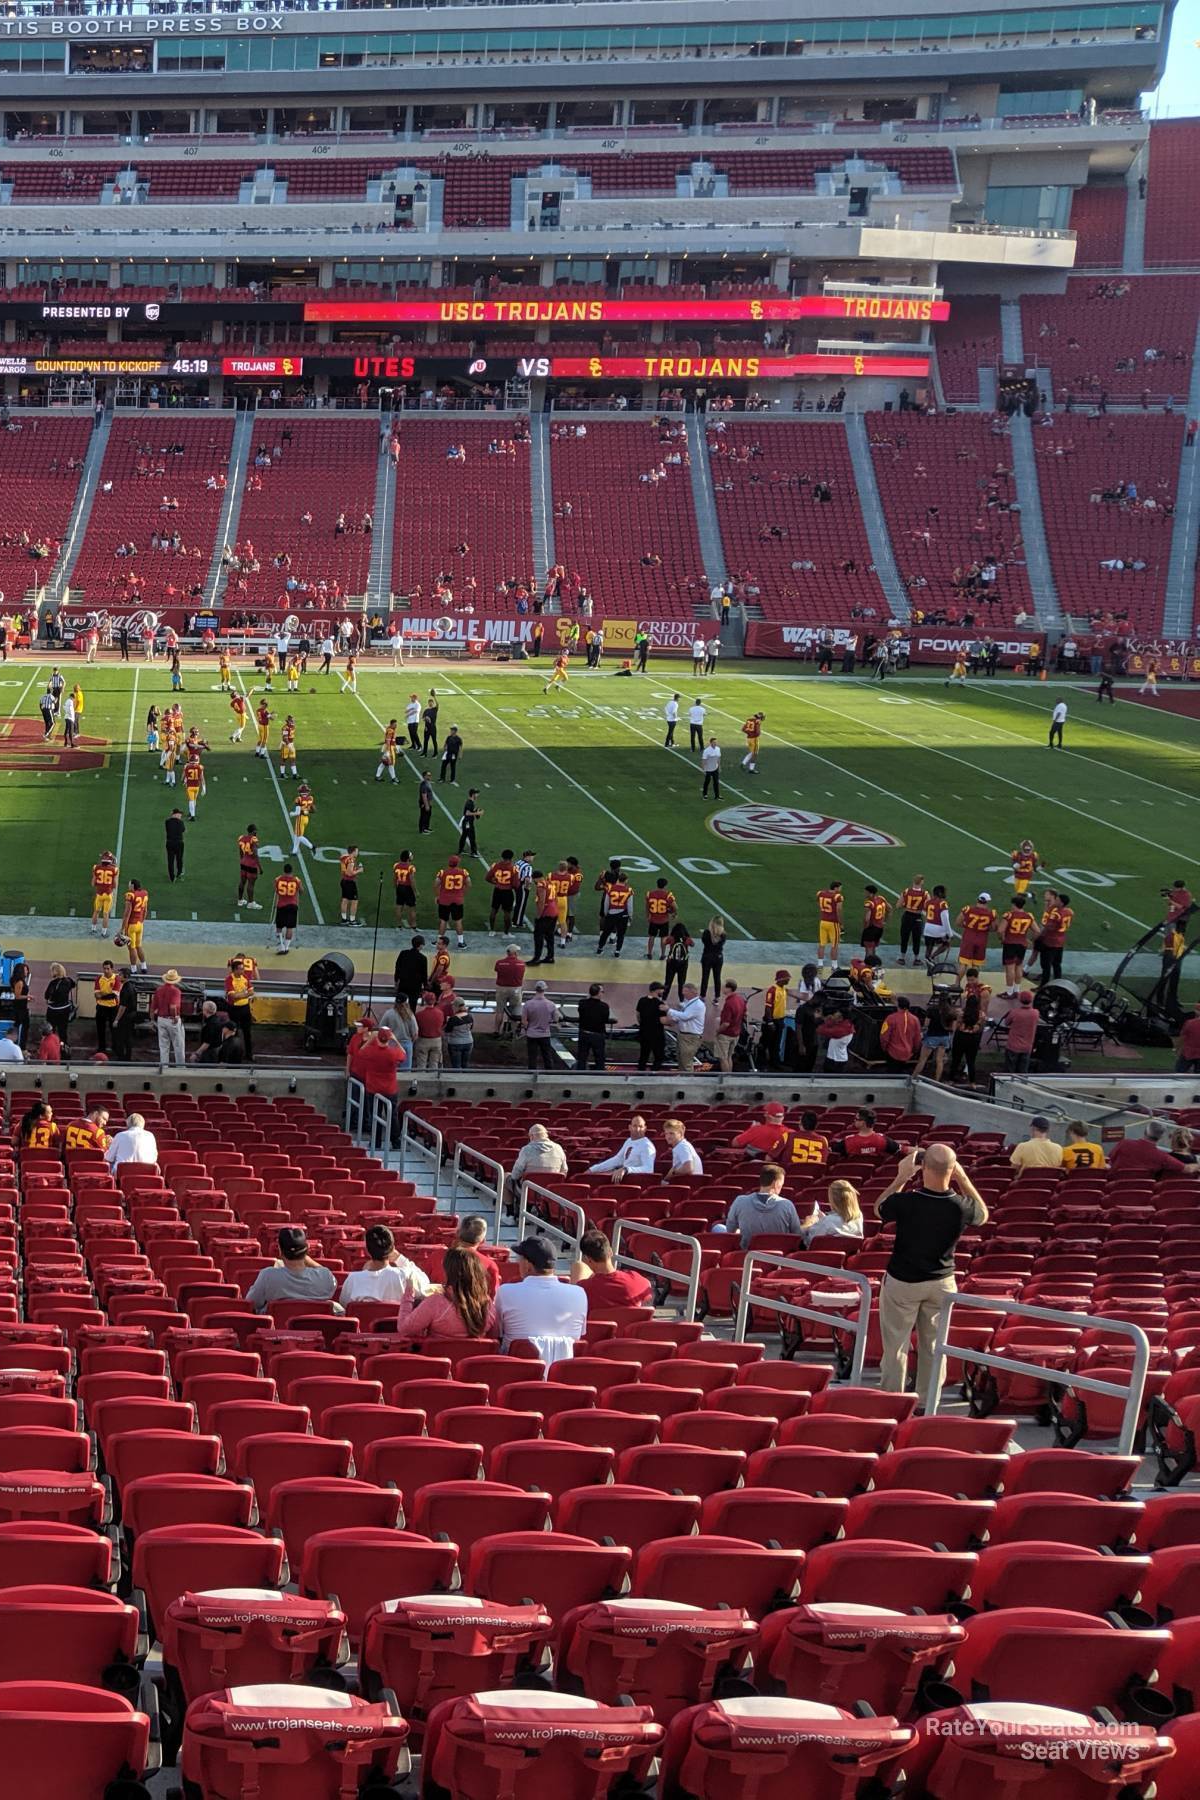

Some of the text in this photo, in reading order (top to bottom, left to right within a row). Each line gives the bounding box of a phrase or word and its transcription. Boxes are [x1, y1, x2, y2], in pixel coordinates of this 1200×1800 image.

[51, 19, 133, 34] BOOTH
[146, 18, 223, 33] PRESS
[237, 16, 284, 31] BOX
[48, 149, 64, 158] 406
[183, 147, 199, 156] 407
[311, 145, 327, 154] 408
[453, 143, 469, 152] 409
[43, 307, 130, 319] PRESENTED BY
[441, 302, 602, 321] USC TROJANS
[843, 298, 932, 319] TROJANS
[0, 366, 27, 374] FARGO
[35, 360, 161, 373] COUNTDOWN TO KICKOFF
[173, 359, 208, 373] 45:19
[231, 361, 276, 372] TROJANS
[354, 357, 414, 377] UTES
[521, 358, 550, 377] VS
[644, 358, 760, 377] TROJANS
[484, 620, 533, 642] MILK
[604, 627, 634, 640] USC
[638, 620, 699, 635] CREDIT
[918, 637, 1033, 655] POWEADE
[188, 769, 199, 781] 31
[258, 845, 348, 863] 40
[608, 855, 731, 876] 30
[96, 869, 113, 885] 36
[445, 875, 463, 890] 63
[278, 880, 297, 896] 58
[610, 891, 629, 906] 27
[649, 898, 667, 914] 36
[819, 897, 832, 912] 15
[908, 895, 923, 910] 17
[968, 913, 990, 931] 72
[1010, 918, 1032, 935] 97
[65, 1127, 93, 1149] 55
[791, 1137, 823, 1163] 55
[204, 1613, 318, 1628] www.trojanseats.com
[416, 1615, 533, 1630] www.trojanseats.com
[621, 1622, 736, 1637] www.trojanseats.com
[828, 1628, 943, 1643] www.trojanseats.com
[231, 1717, 374, 1735] www.trojanseats.com
[494, 1727, 636, 1744] www.trojanseats.com
[738, 1732, 883, 1749] www.trojanseats.com
